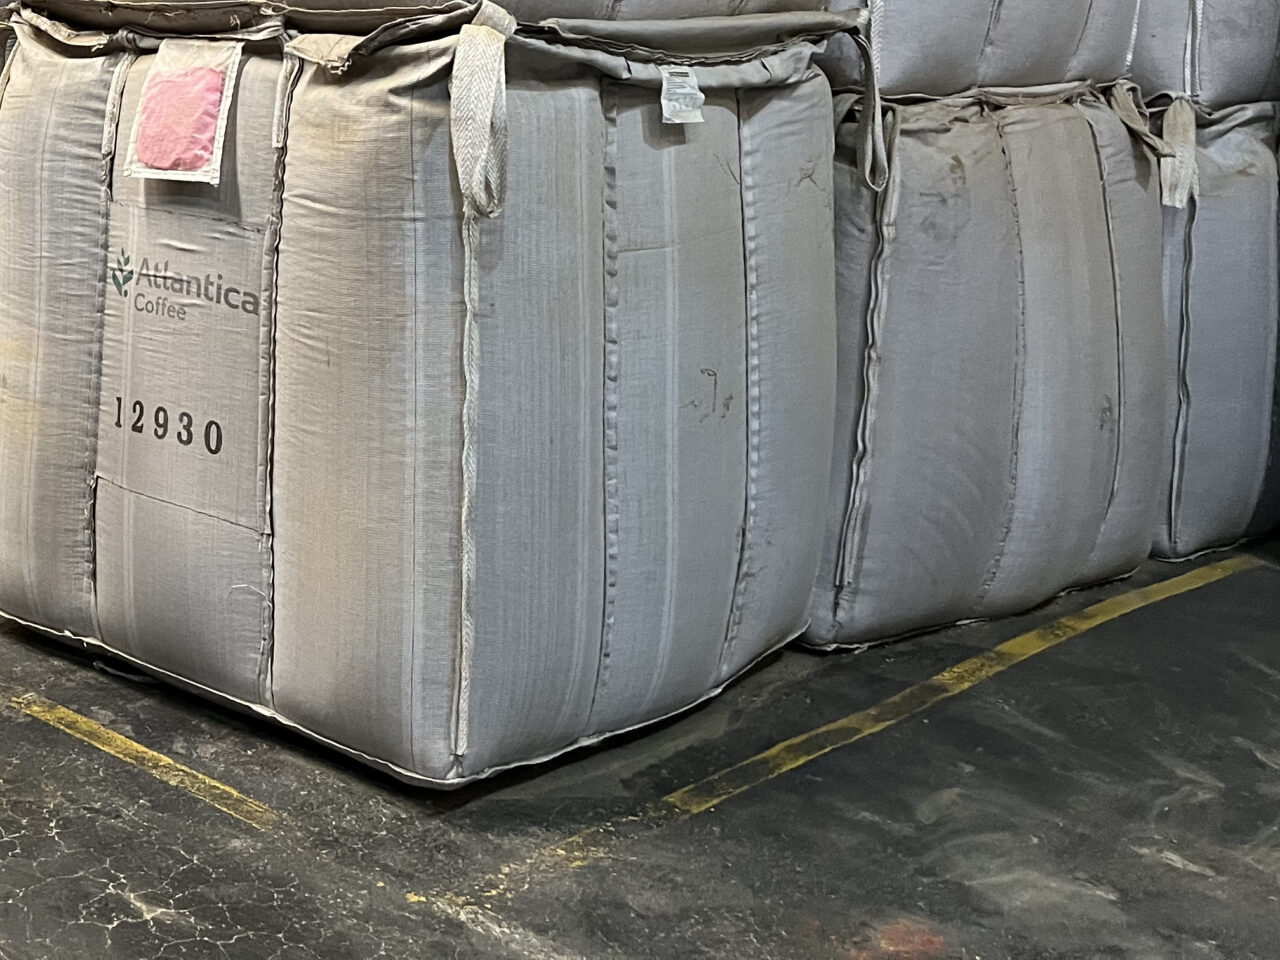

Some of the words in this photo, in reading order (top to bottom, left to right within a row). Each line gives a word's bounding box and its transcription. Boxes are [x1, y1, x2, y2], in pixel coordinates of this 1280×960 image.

[134, 292, 188, 321] Coffee
[136, 257, 260, 316] Atlantica
[114, 396, 223, 455] 12930
